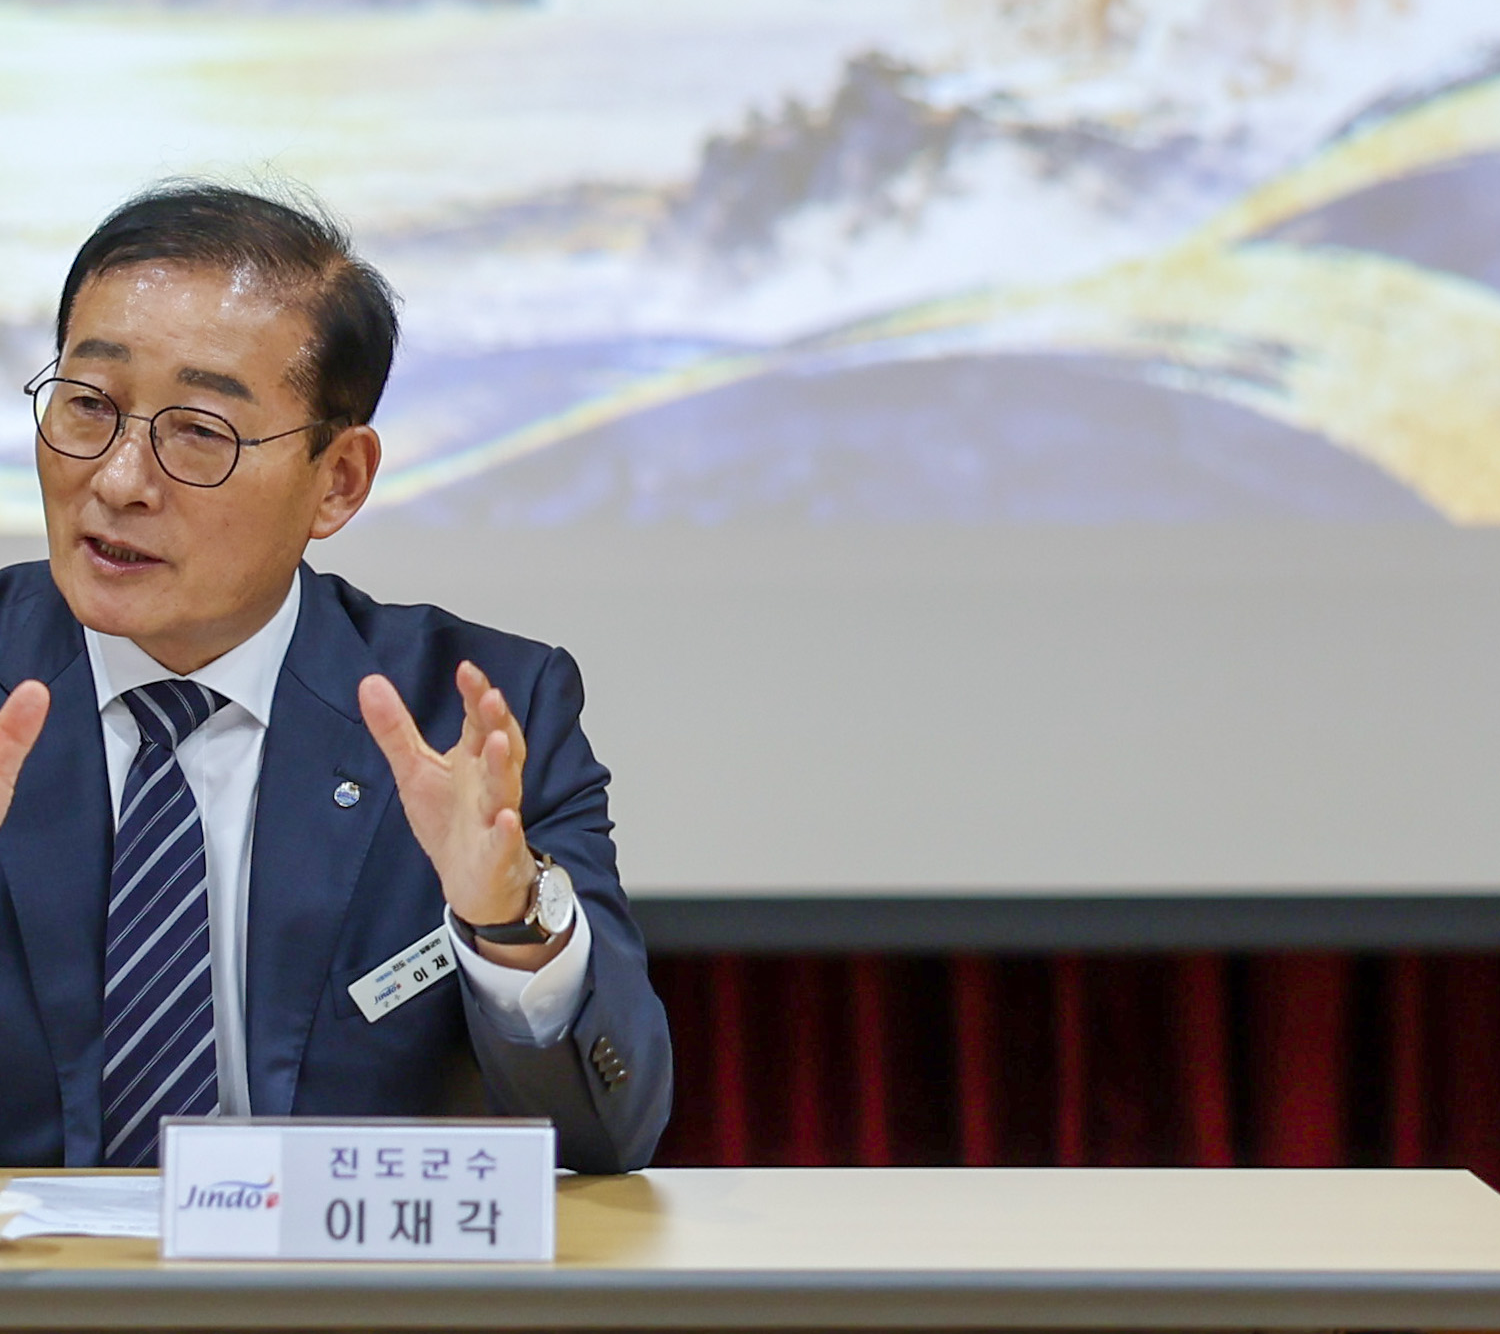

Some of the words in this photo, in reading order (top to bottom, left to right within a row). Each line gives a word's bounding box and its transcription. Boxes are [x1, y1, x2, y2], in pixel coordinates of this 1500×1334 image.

[413, 954, 450, 983] 이재
[374, 982, 398, 1005] Jindo
[330, 1148, 497, 1180] 진도군수
[179, 1179, 268, 1210] Jindo
[324, 1199, 502, 1246] 이재각
